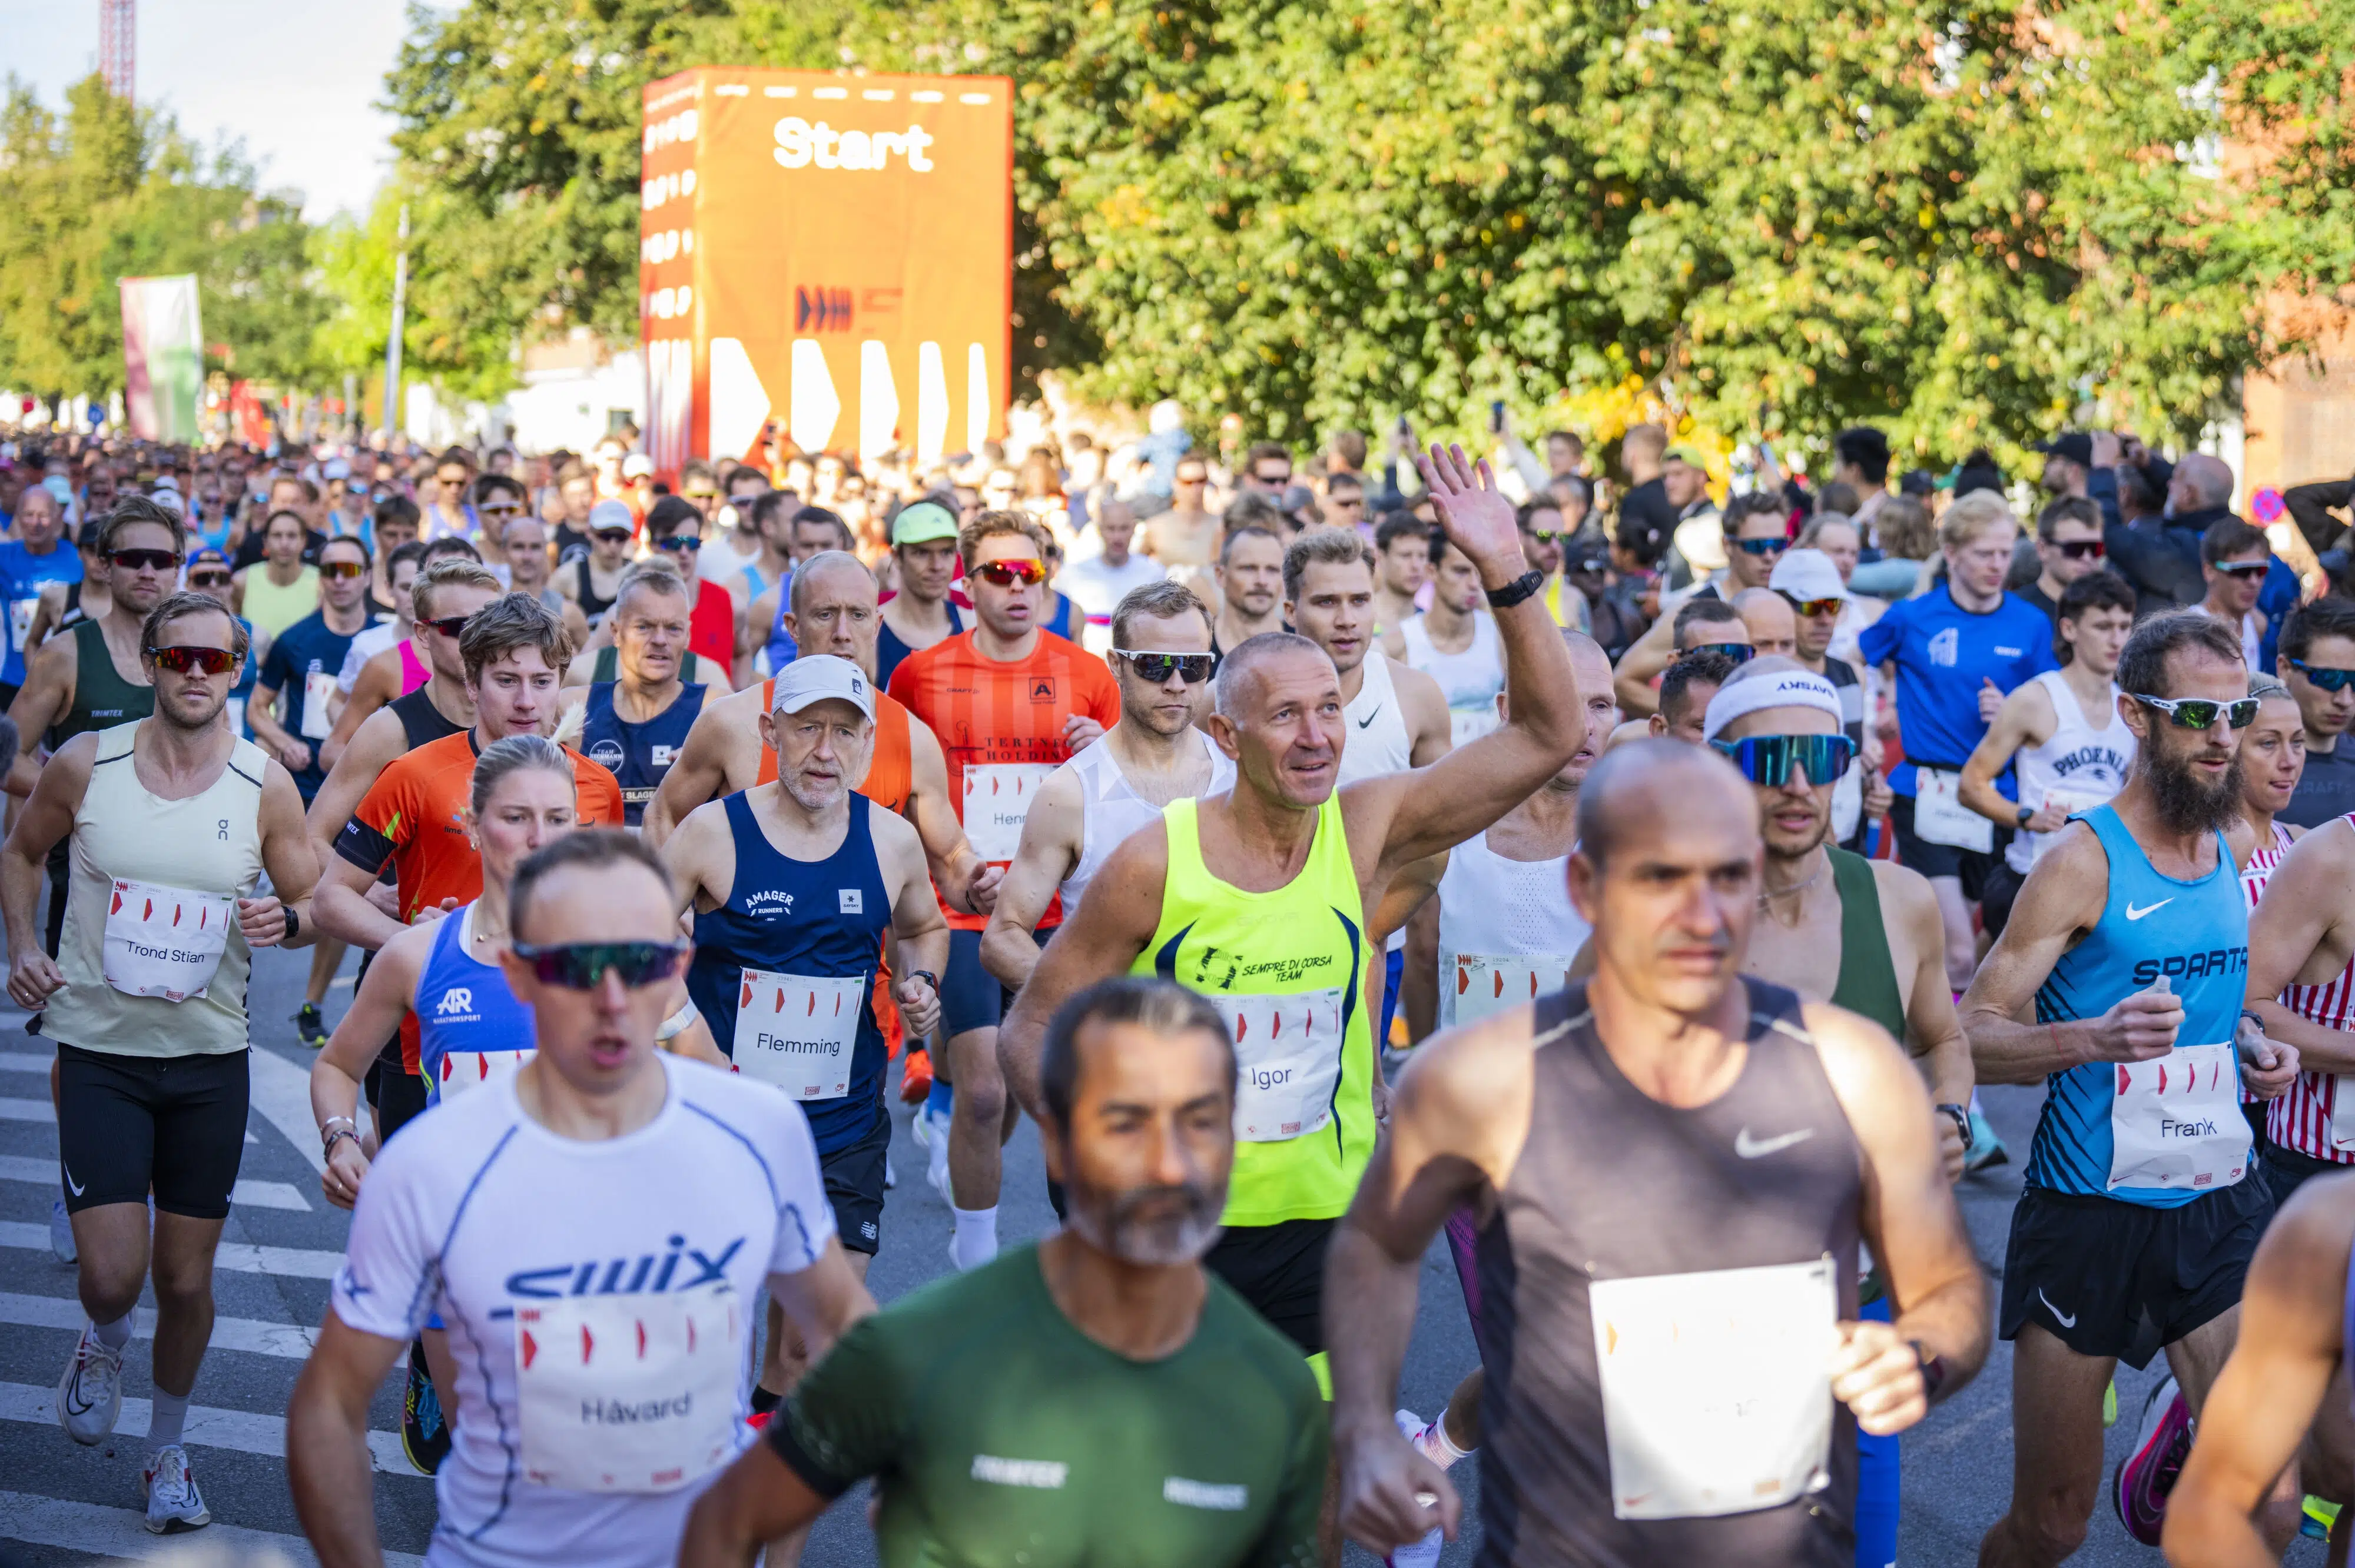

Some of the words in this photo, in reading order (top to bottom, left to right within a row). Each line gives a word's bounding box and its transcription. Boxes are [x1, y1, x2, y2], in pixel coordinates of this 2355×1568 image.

[772, 117, 934, 172] Start
[91, 709, 122, 717] TRIMTEX
[745, 890, 794, 909] AMAGER
[127, 940, 168, 960] Trond
[171, 949, 205, 964] Stian
[1242, 961, 1287, 976] SEMPRE
[1288, 959, 1301, 971] DI
[1301, 955, 1332, 969] CORSA
[1275, 970, 1303, 982] TEAM
[757, 1032, 841, 1057] Flemming
[1251, 1067, 1292, 1090] Igor
[2162, 1117, 2217, 1138] Frank
[580, 1389, 692, 1425] Håvard
